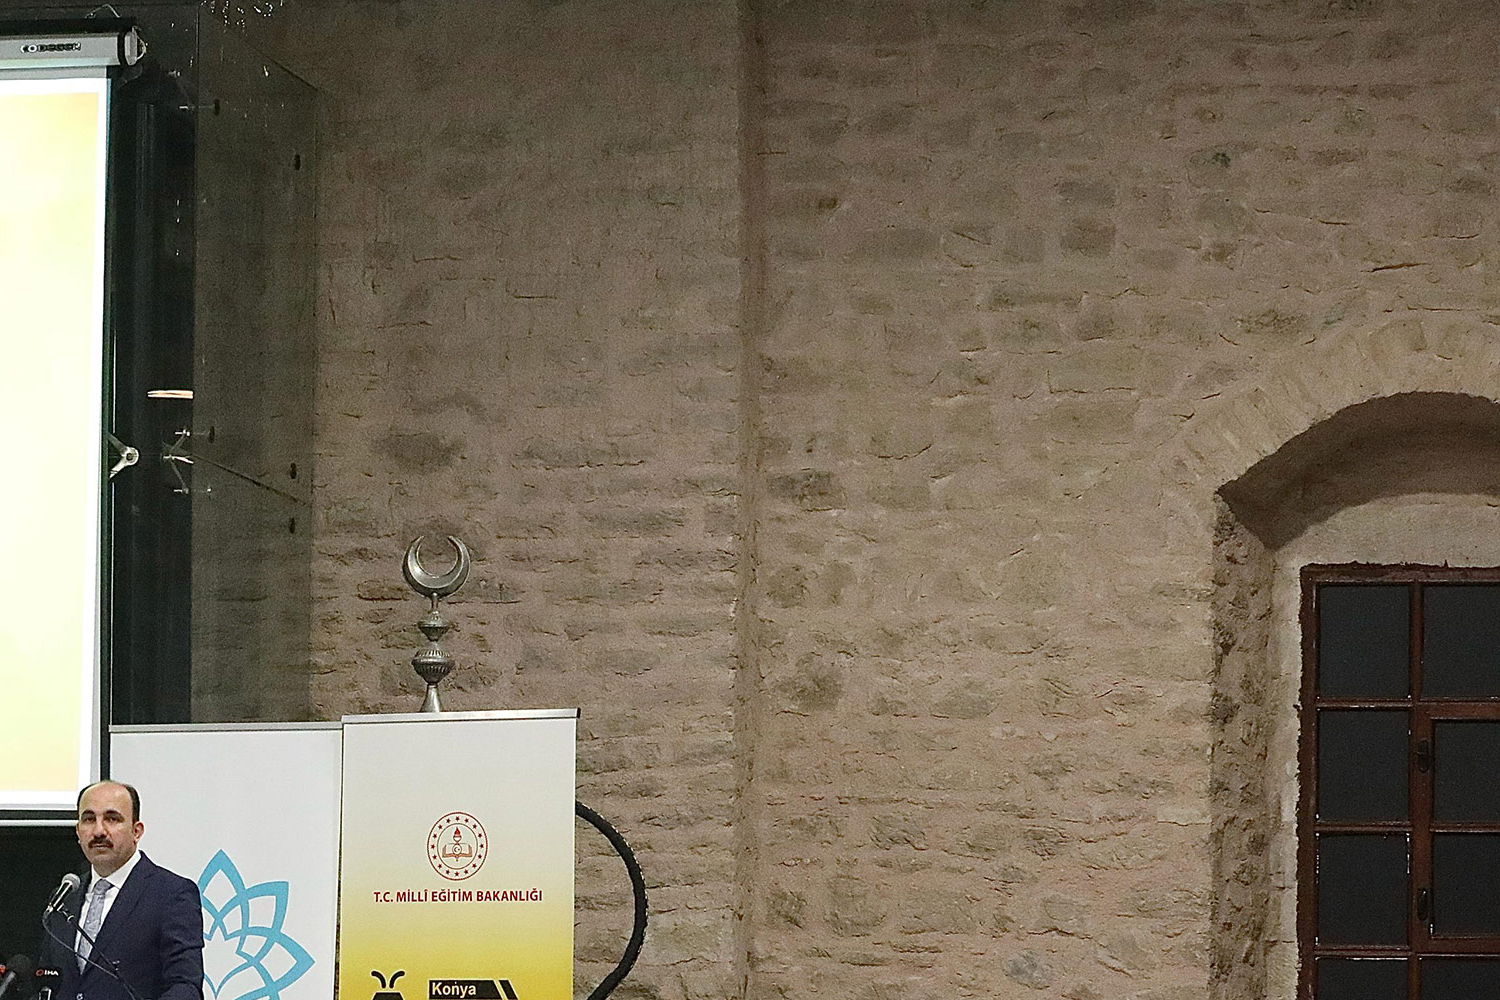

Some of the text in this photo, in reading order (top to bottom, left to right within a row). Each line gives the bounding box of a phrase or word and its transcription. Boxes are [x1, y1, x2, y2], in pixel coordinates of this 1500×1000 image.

[373, 891, 394, 903] T.C.
[431, 888, 473, 902] EĞİTİM
[476, 888, 542, 902] BAKANLIĞI
[431, 982, 477, 998] Konya
